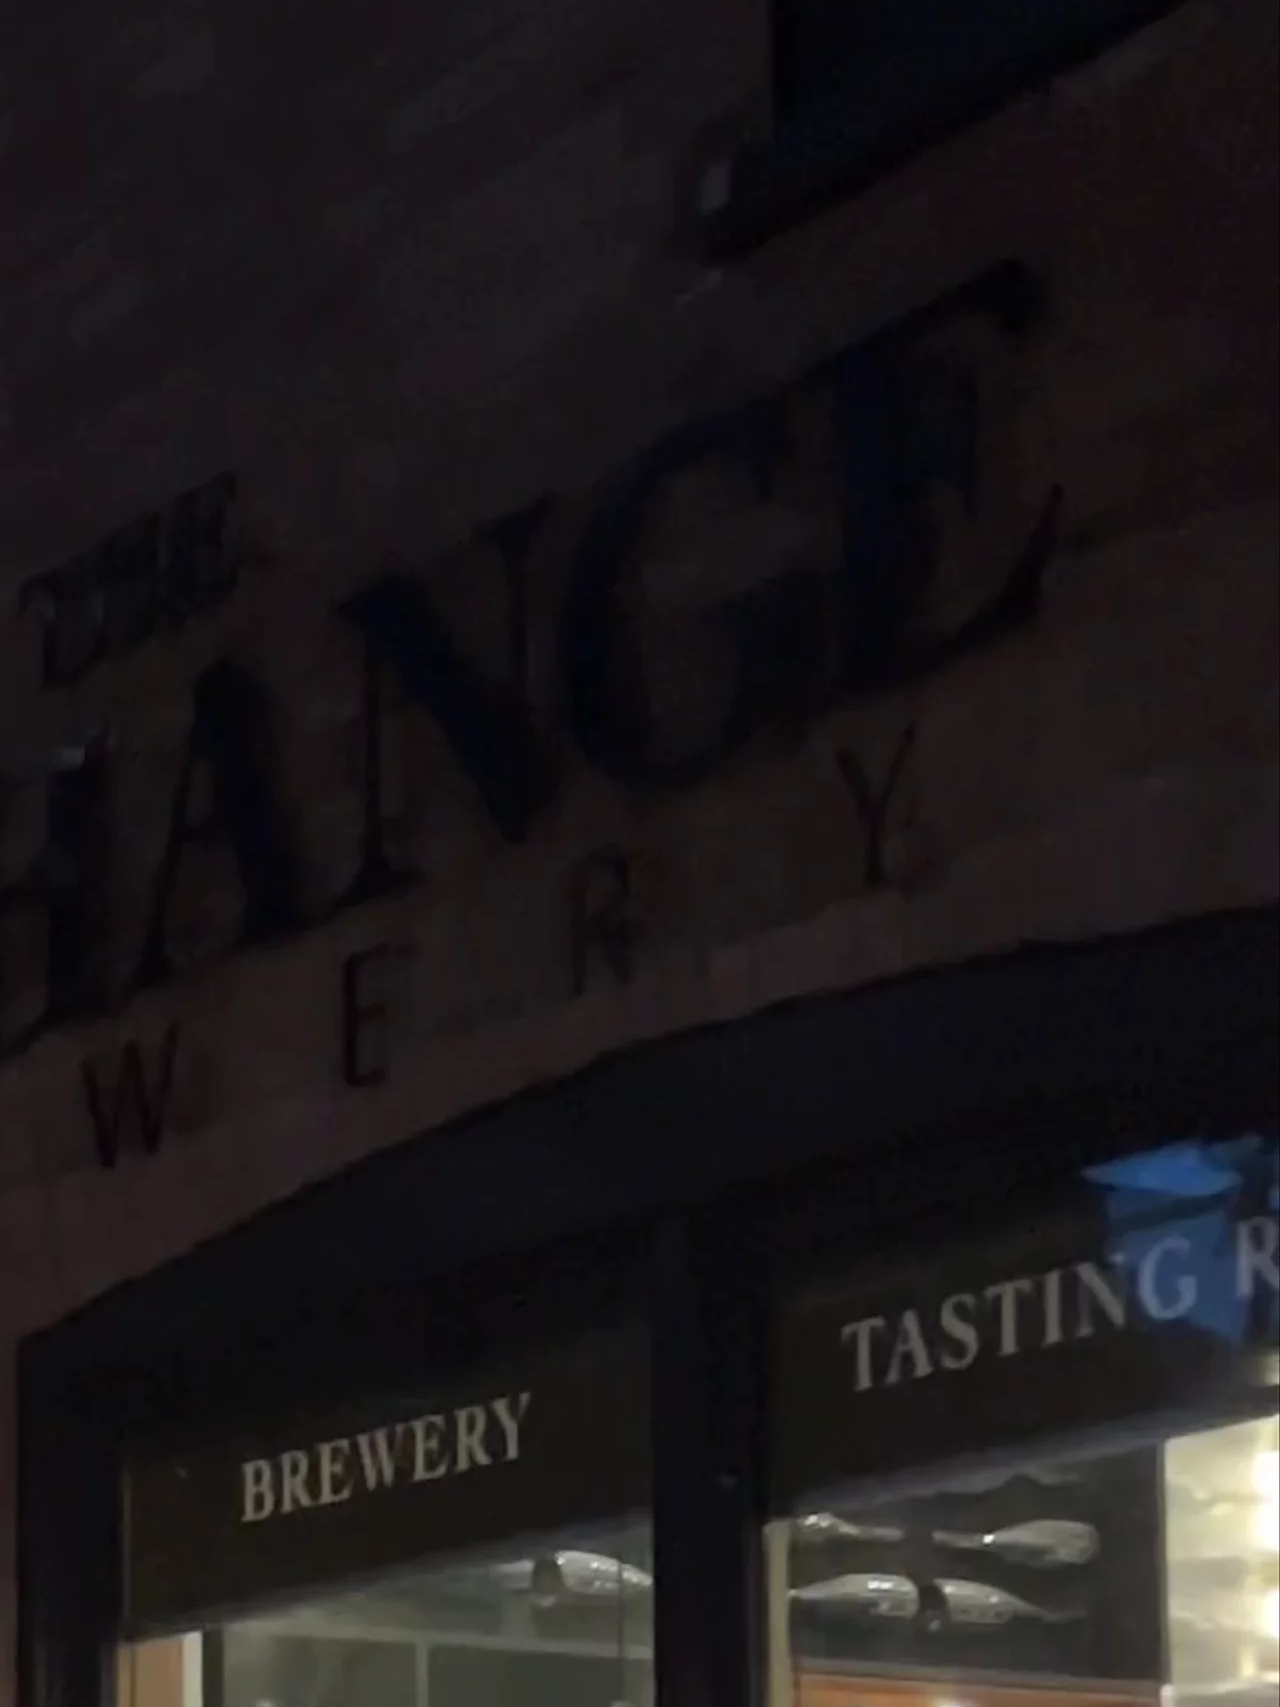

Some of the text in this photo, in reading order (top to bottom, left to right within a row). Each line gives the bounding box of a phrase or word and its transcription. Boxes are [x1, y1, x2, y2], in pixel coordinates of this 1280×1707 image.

[18, 471, 240, 690] THE
[839, 1235, 1198, 1391] TASTING
[239, 1390, 532, 1523] BREWERY
